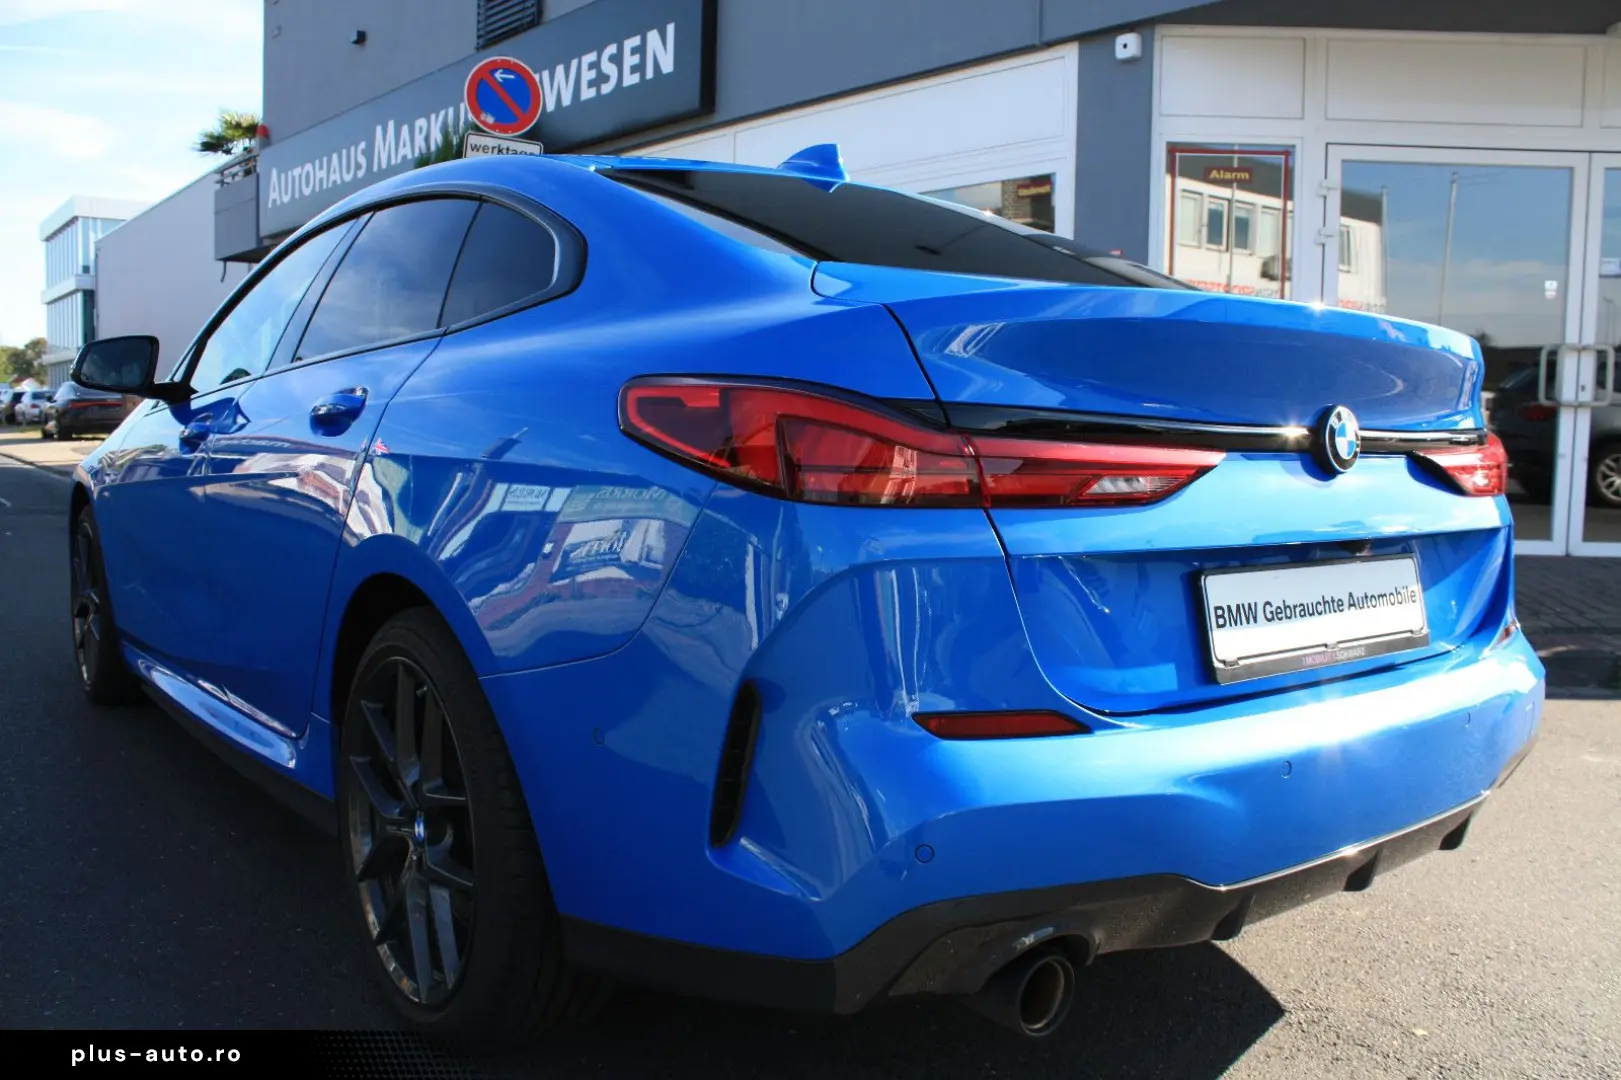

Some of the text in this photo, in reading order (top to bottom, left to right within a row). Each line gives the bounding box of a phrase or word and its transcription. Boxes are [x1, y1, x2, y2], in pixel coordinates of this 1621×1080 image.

[268, 140, 367, 209] AUTOHAUS
[372, 102, 474, 174] MARKU
[1209, 169, 1250, 180] Alarm
[1213, 586, 1417, 629] BMW Gebrauchte Automobile
